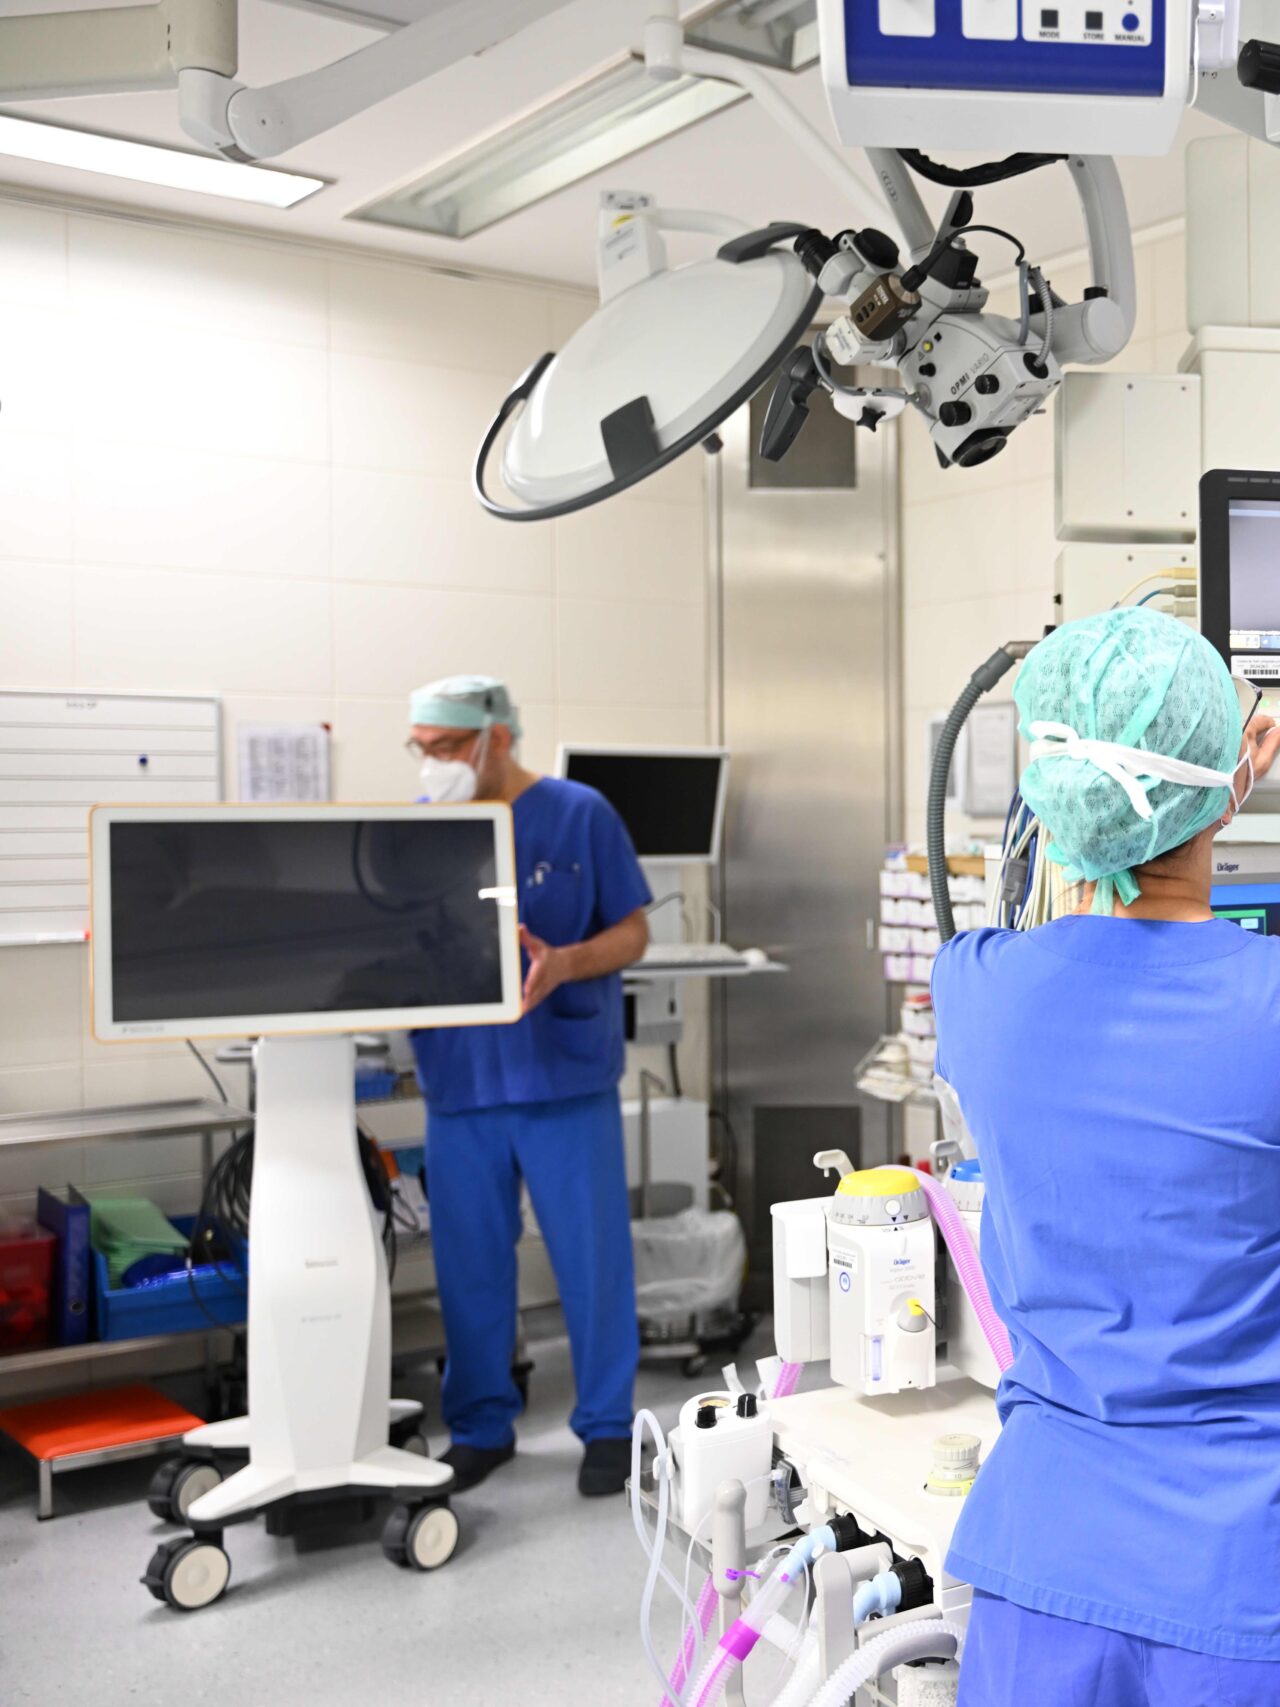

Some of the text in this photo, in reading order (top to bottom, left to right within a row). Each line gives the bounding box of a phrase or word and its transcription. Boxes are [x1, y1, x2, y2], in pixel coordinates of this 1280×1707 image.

[1039, 31, 1060, 39] MODE
[1083, 32, 1104, 41] STORE
[1114, 33, 1145, 42] MANUAL
[950, 352, 990, 396] OPMI VARIO
